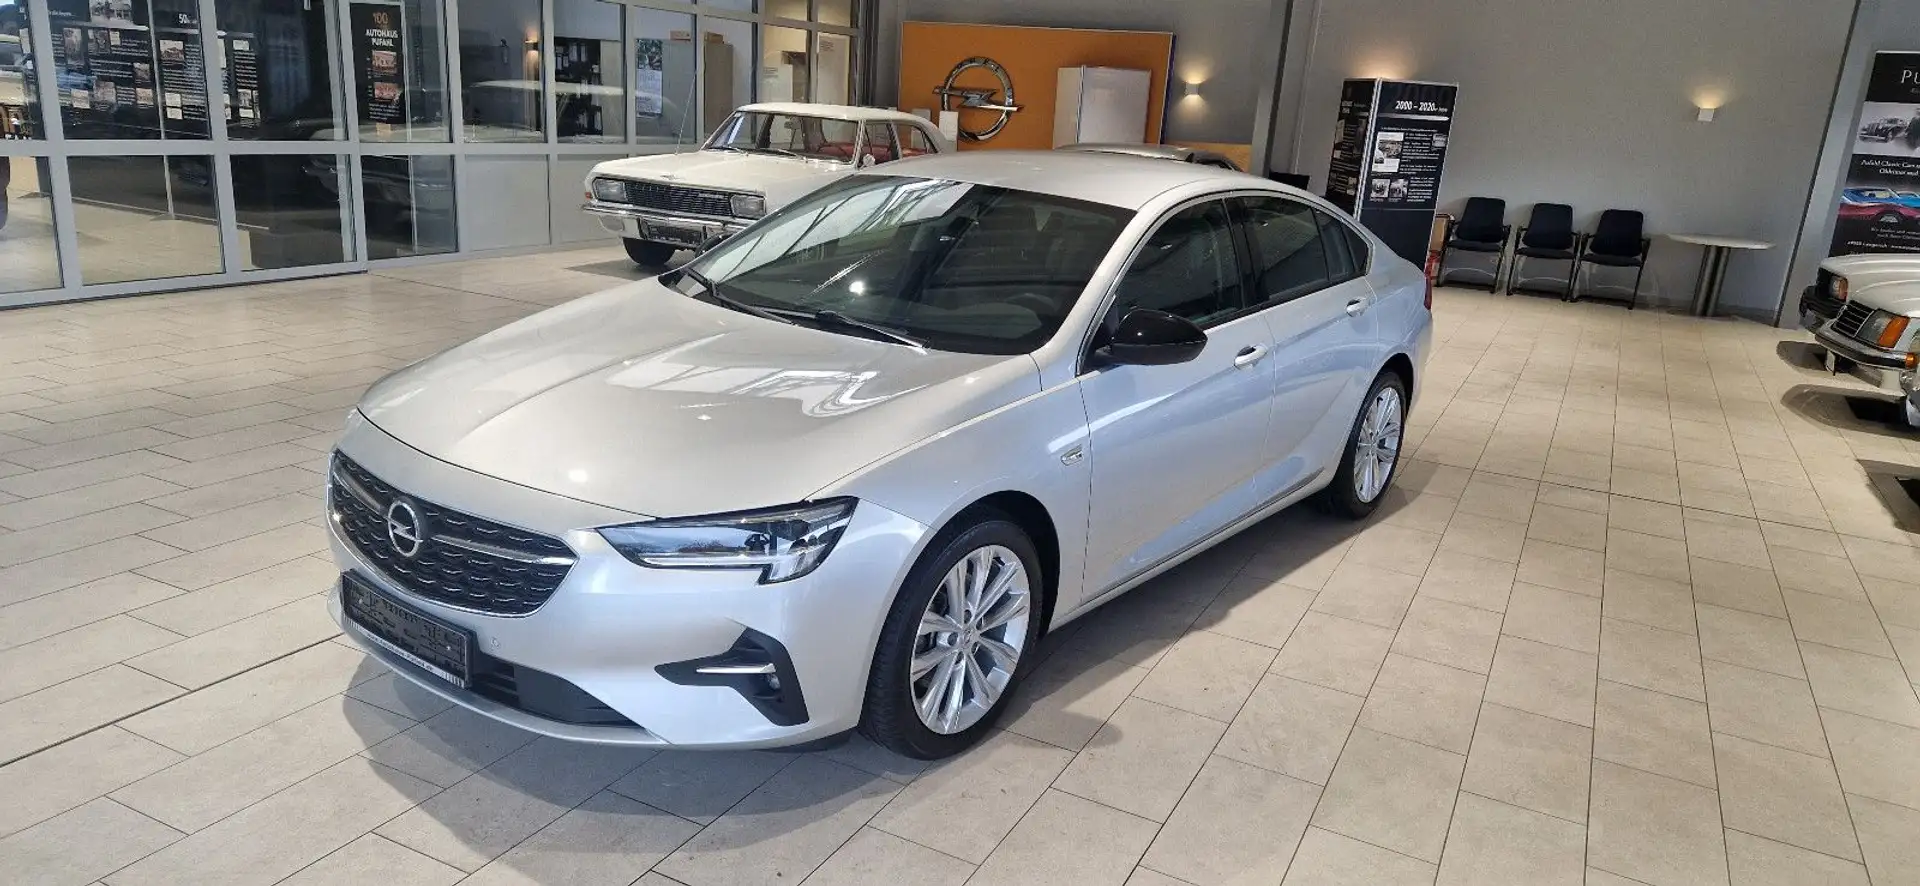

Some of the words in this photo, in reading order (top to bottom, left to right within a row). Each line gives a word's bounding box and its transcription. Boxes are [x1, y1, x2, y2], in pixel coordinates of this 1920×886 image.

[373, 12, 389, 25] 100
[365, 29, 398, 38] AUTOHAUS
[371, 38, 394, 47] PUFAHL
[1395, 100, 1413, 110] 2000
